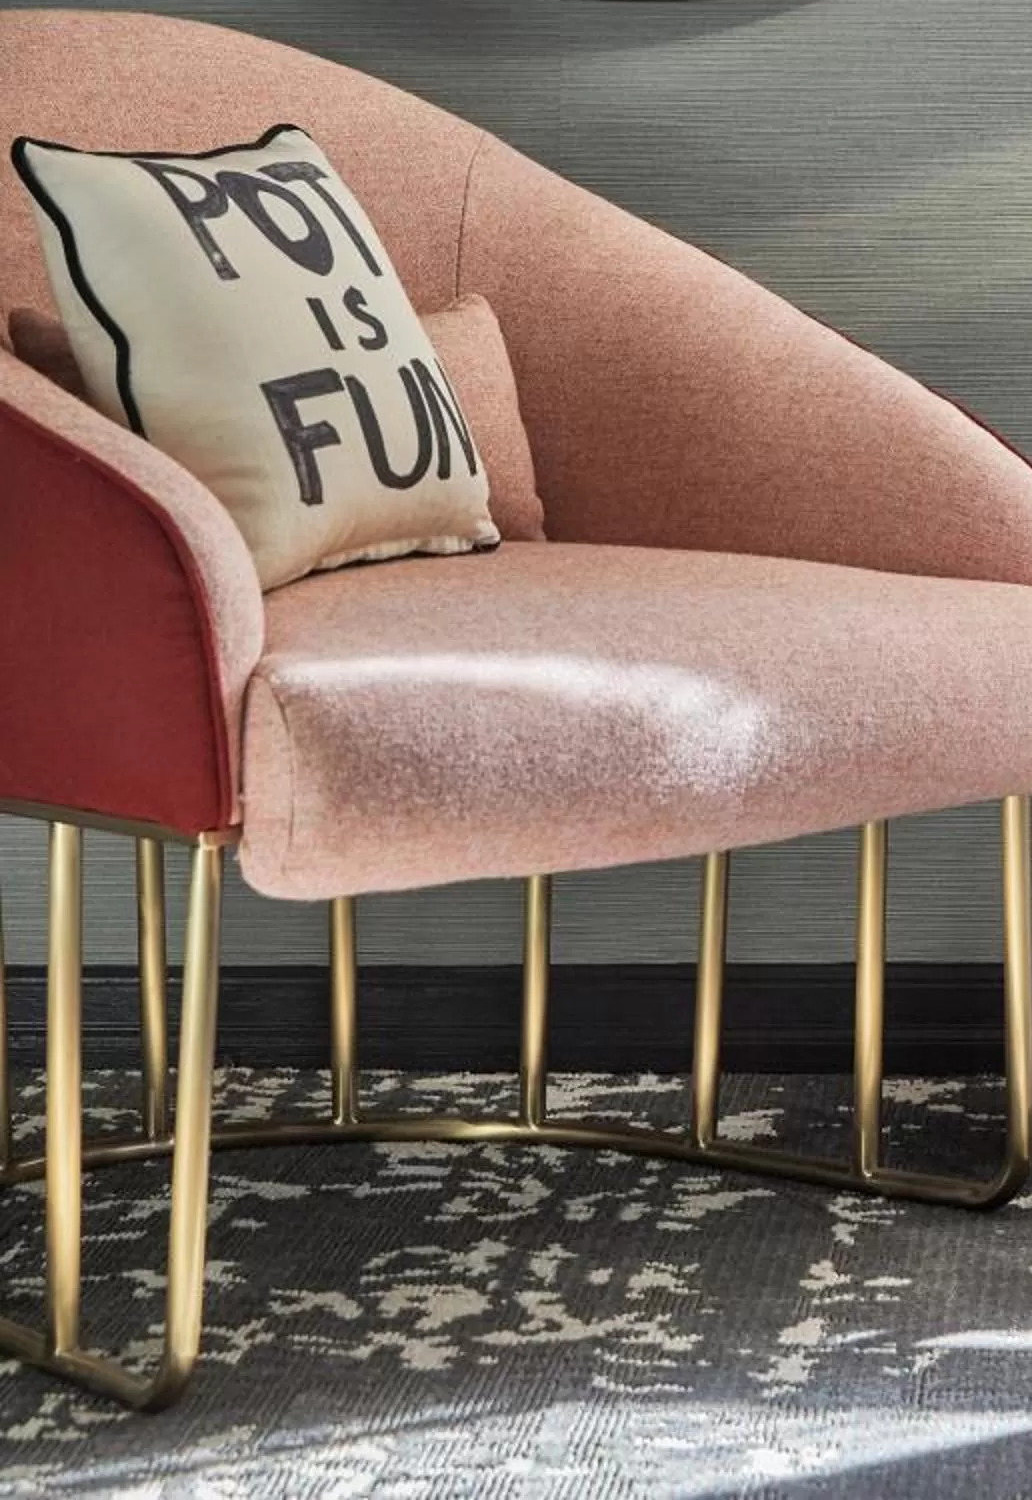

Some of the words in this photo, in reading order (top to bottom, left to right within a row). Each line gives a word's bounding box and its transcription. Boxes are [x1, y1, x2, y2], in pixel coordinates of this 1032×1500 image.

[132, 160, 383, 281] POT
[305, 285, 389, 352] IS
[260, 357, 478, 507] FUN
